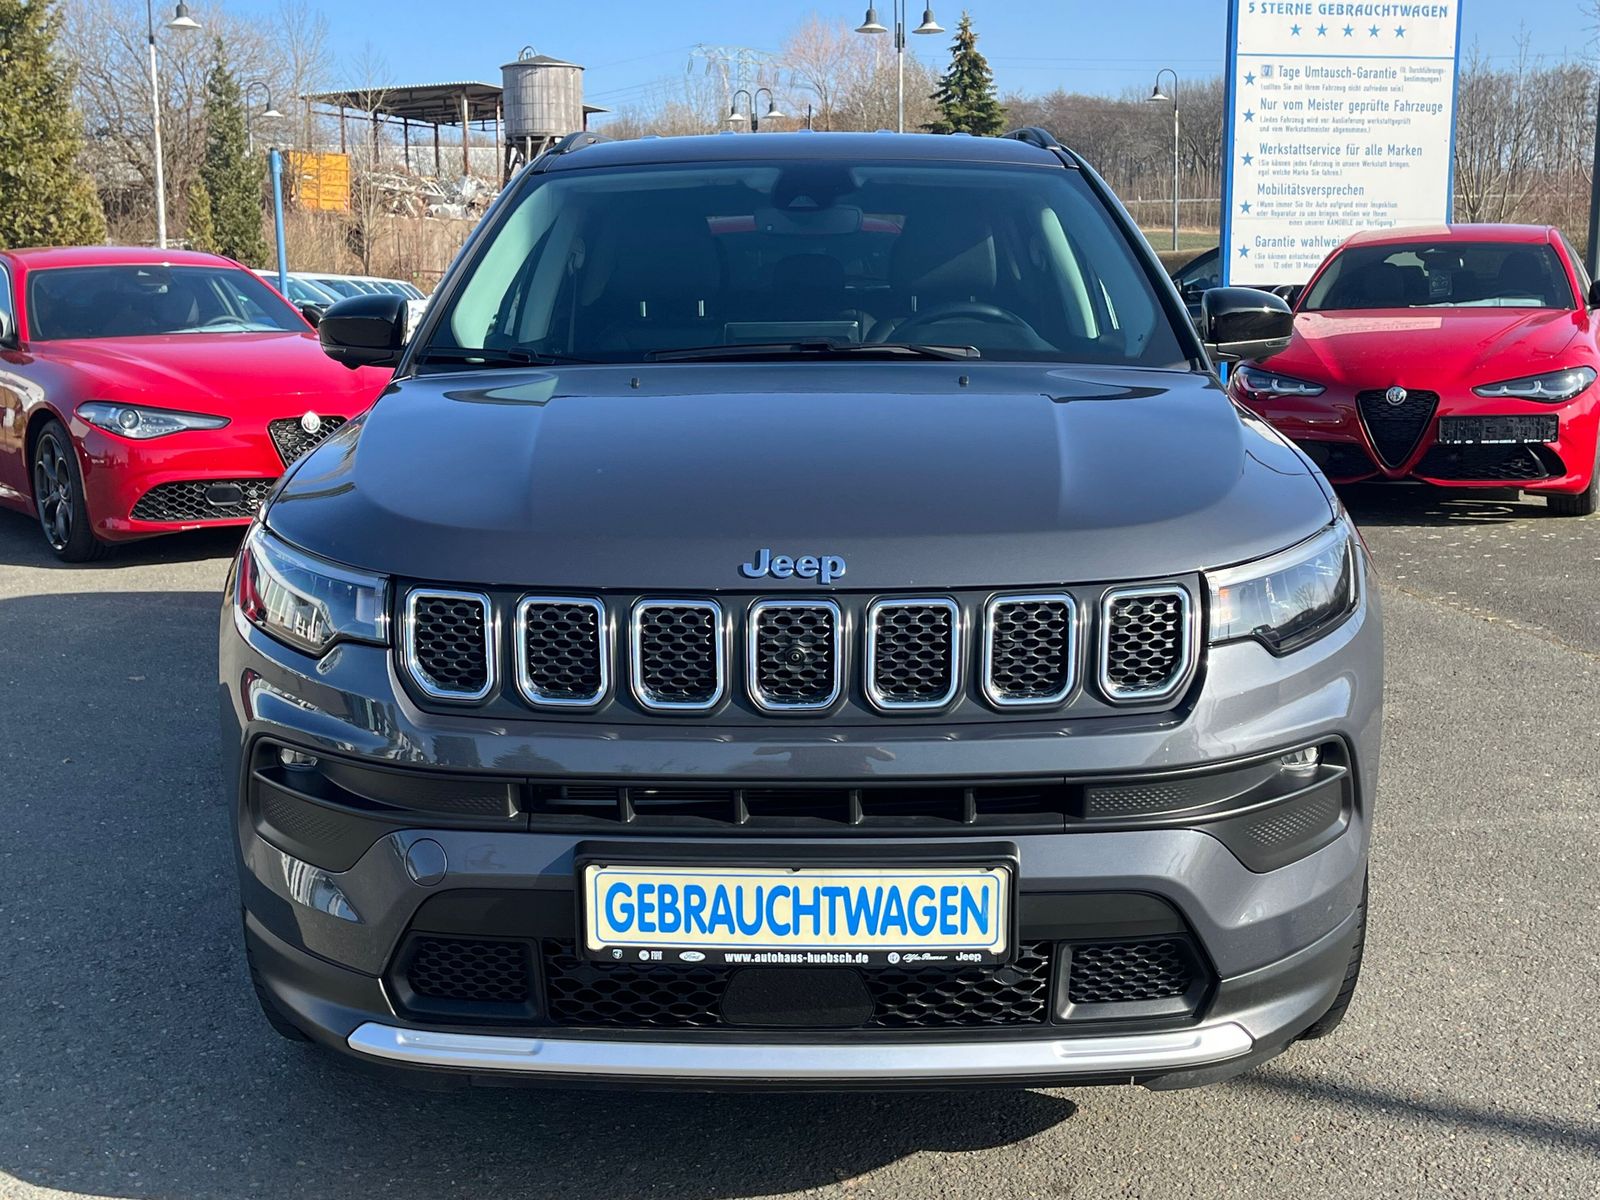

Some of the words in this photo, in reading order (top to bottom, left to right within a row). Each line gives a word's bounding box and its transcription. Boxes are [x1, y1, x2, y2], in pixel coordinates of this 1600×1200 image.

[1249, 2, 1255, 13] 5
[1261, 2, 1312, 15] STERNE
[1318, 3, 1448, 18] GEBRAUCHTWAGEN
[1279, 65, 1300, 81] Tage
[1305, 66, 1397, 79] Umtausch-Garantie
[1283, 83, 1291, 91] Sie
[1293, 83, 1302, 91] mit
[1322, 84, 1346, 93] Fahrzeug
[1348, 84, 1361, 92] nicht
[1363, 84, 1388, 92] zufrieden
[1260, 97, 1277, 110] Nur
[1283, 100, 1303, 110] vom
[1308, 98, 1343, 111] Meister
[1348, 99, 1390, 115] geprüfte
[1394, 100, 1443, 115] Fahrzeuge
[1280, 116, 1304, 125] Fahrzeug
[1285, 125, 1330, 133] Werkstattmeister
[1259, 142, 1341, 155] Werkstattservice
[1346, 143, 1360, 156] für
[1365, 144, 1382, 156] alle
[1387, 144, 1423, 156] Marken
[1293, 160, 1307, 168] jedes
[1309, 160, 1333, 169] Fahrzeug
[1258, 169, 1270, 177] egal
[1257, 183, 1364, 198] Mobilitätsversprechen
[1329, 201, 1353, 210] aufgrund
[1370, 202, 1398, 210] Inspektion
[1271, 210, 1297, 219] Reparatur
[1255, 235, 1296, 247] Garantie
[1268, 252, 1287, 260] können
[1281, 261, 1293, 269] oder
[741, 548, 846, 584] Jeep
[604, 881, 989, 937] GEBRAUCHTWAGEN
[724, 952, 869, 964] www.autohaus-huebsch.de
[955, 952, 982, 963] Jeep
